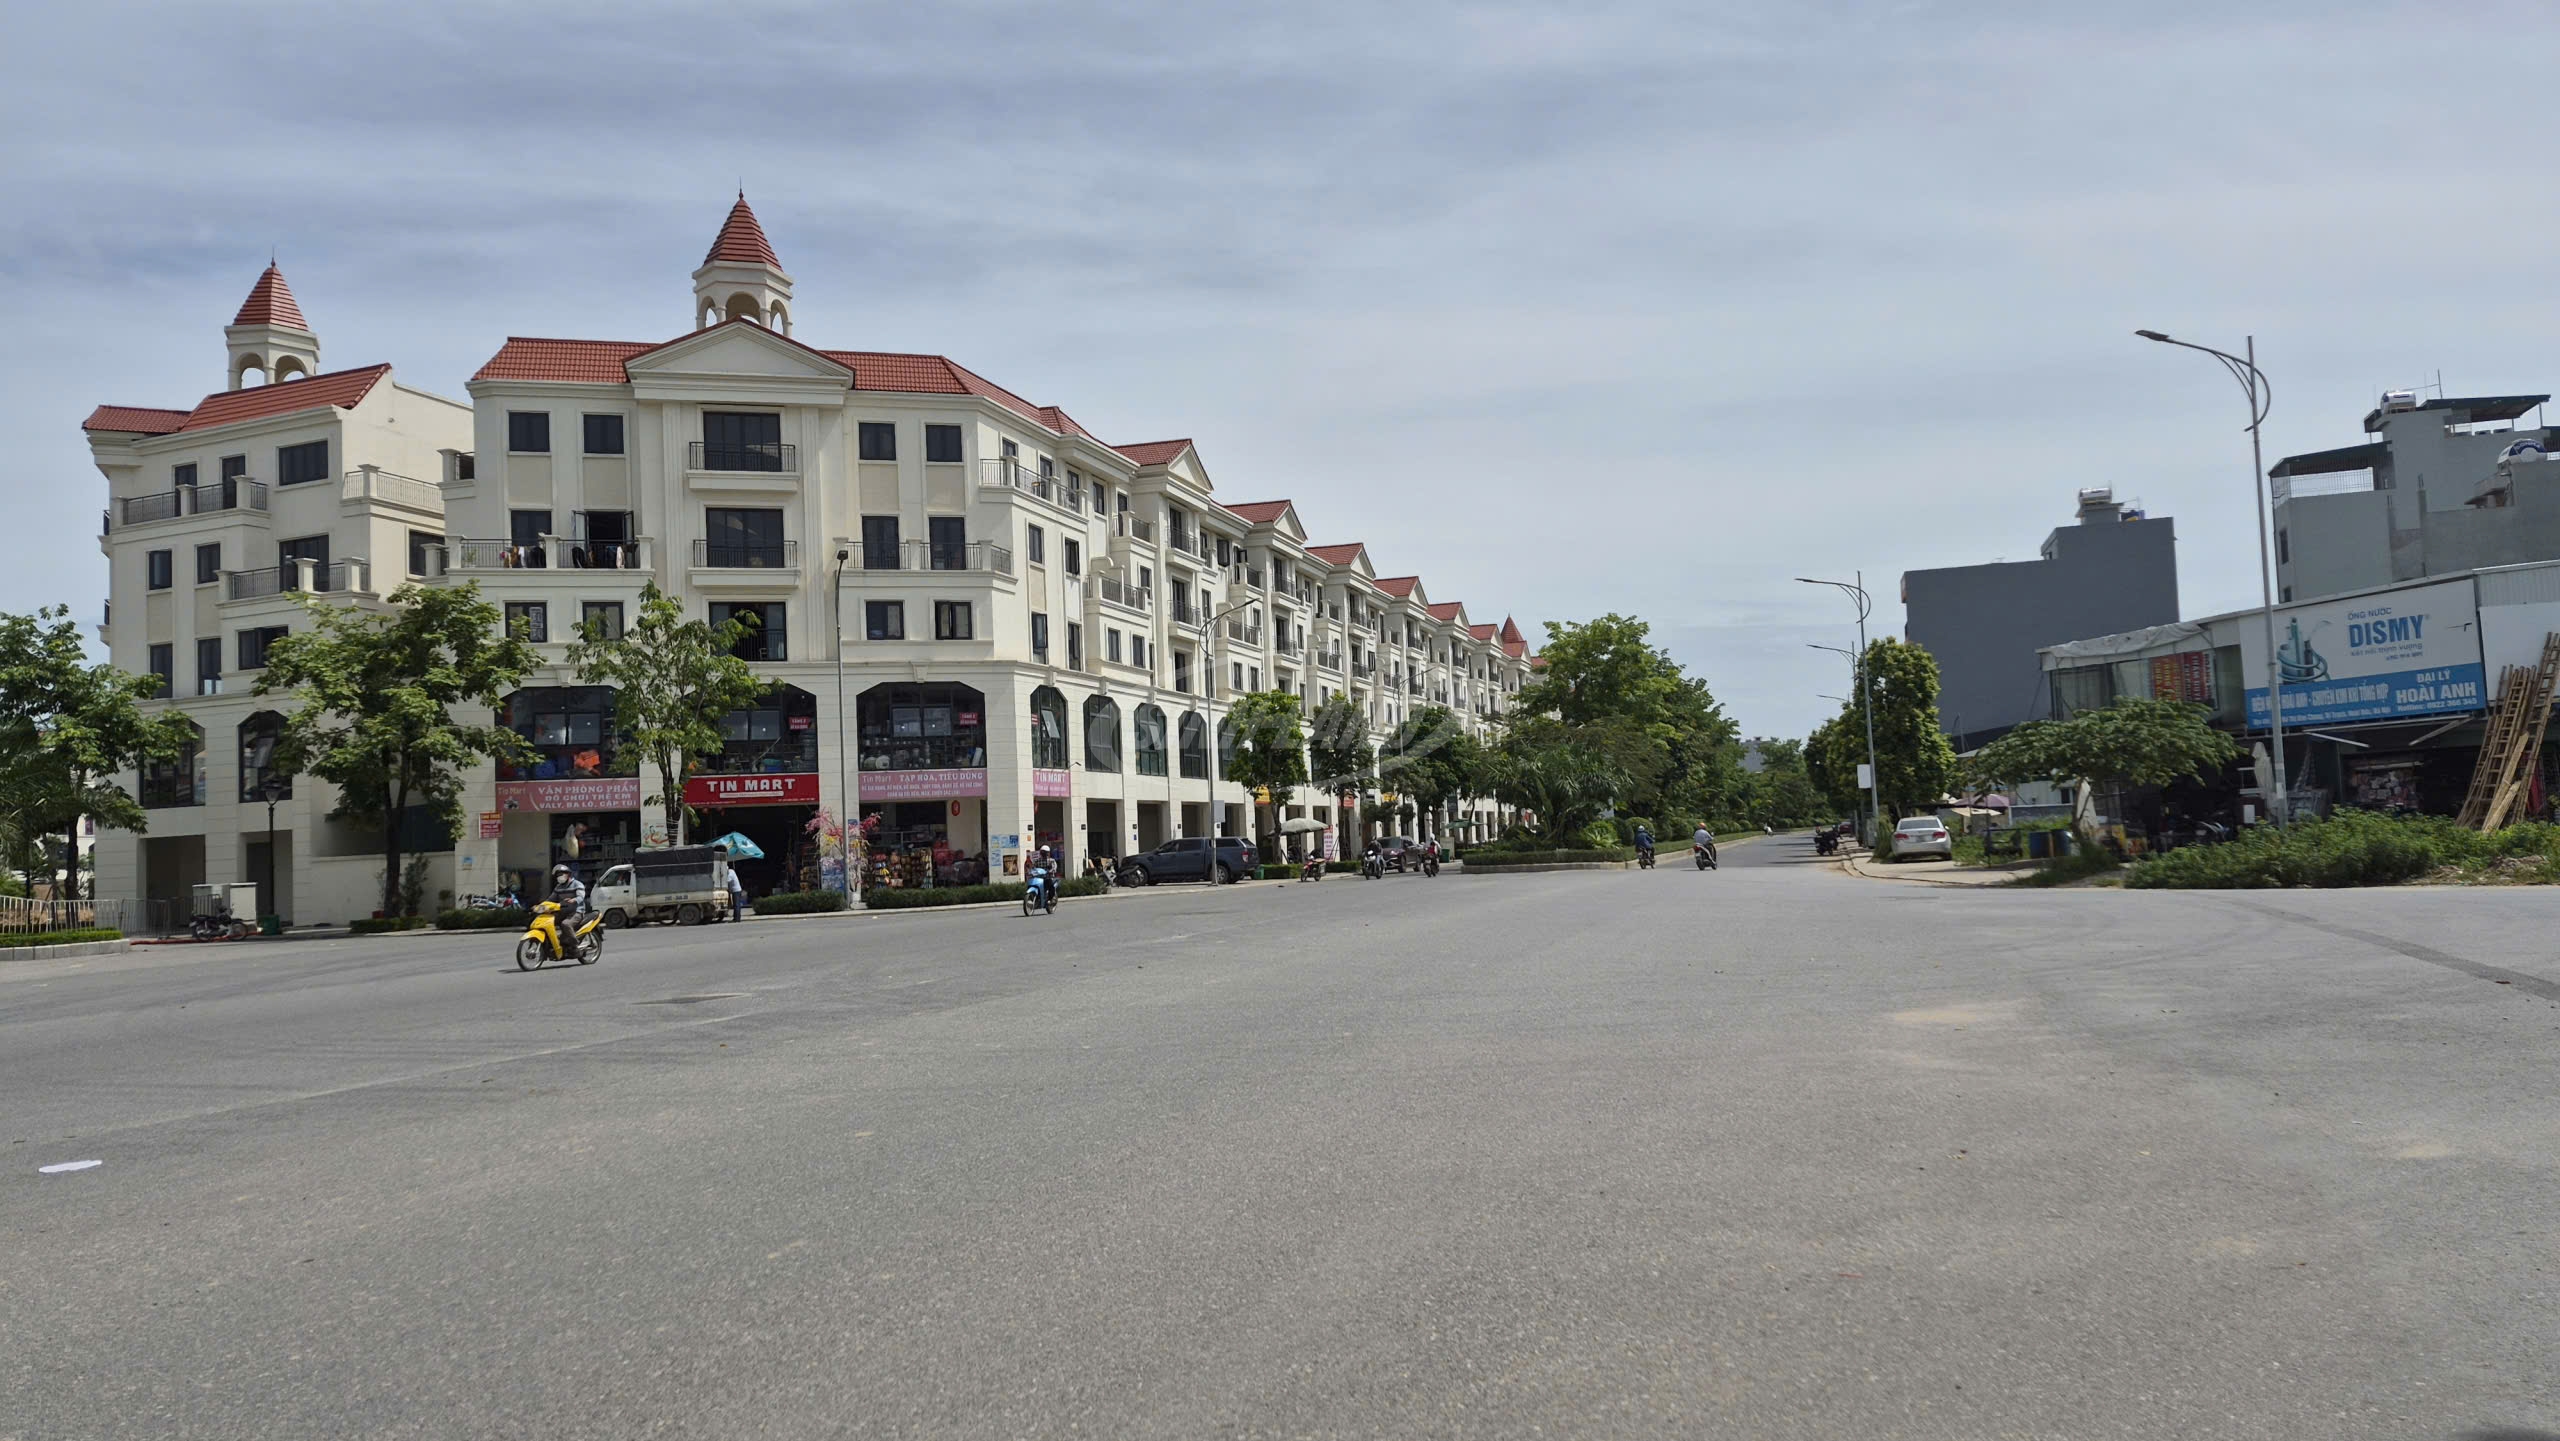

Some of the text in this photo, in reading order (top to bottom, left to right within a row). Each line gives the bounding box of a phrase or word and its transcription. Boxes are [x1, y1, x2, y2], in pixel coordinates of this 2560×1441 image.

[2348, 614, 2424, 648] DISMY
[2416, 668, 2451, 684] ĐẠI LÝ
[2395, 682, 2477, 704] HOÀI ANH
[706, 778, 796, 792] TIN MART
